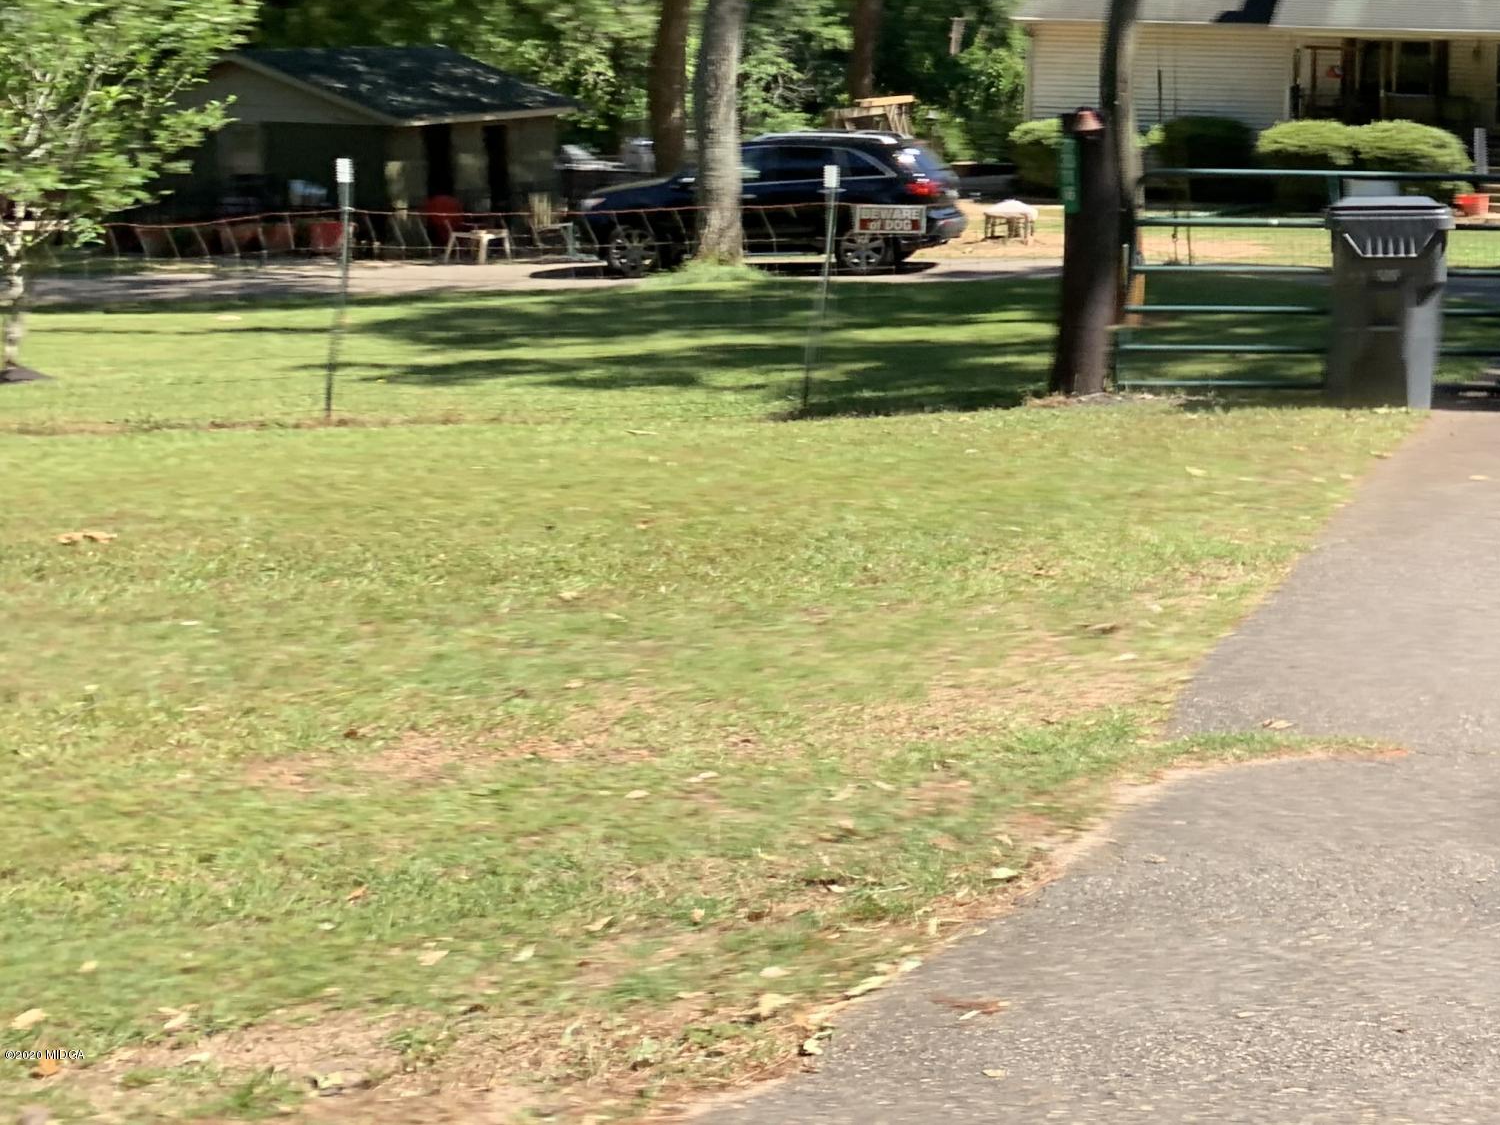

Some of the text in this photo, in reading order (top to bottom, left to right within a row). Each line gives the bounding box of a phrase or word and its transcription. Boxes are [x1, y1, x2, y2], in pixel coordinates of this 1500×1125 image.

[860, 208, 920, 219] BEWARE
[870, 219, 913, 230] of DOG
